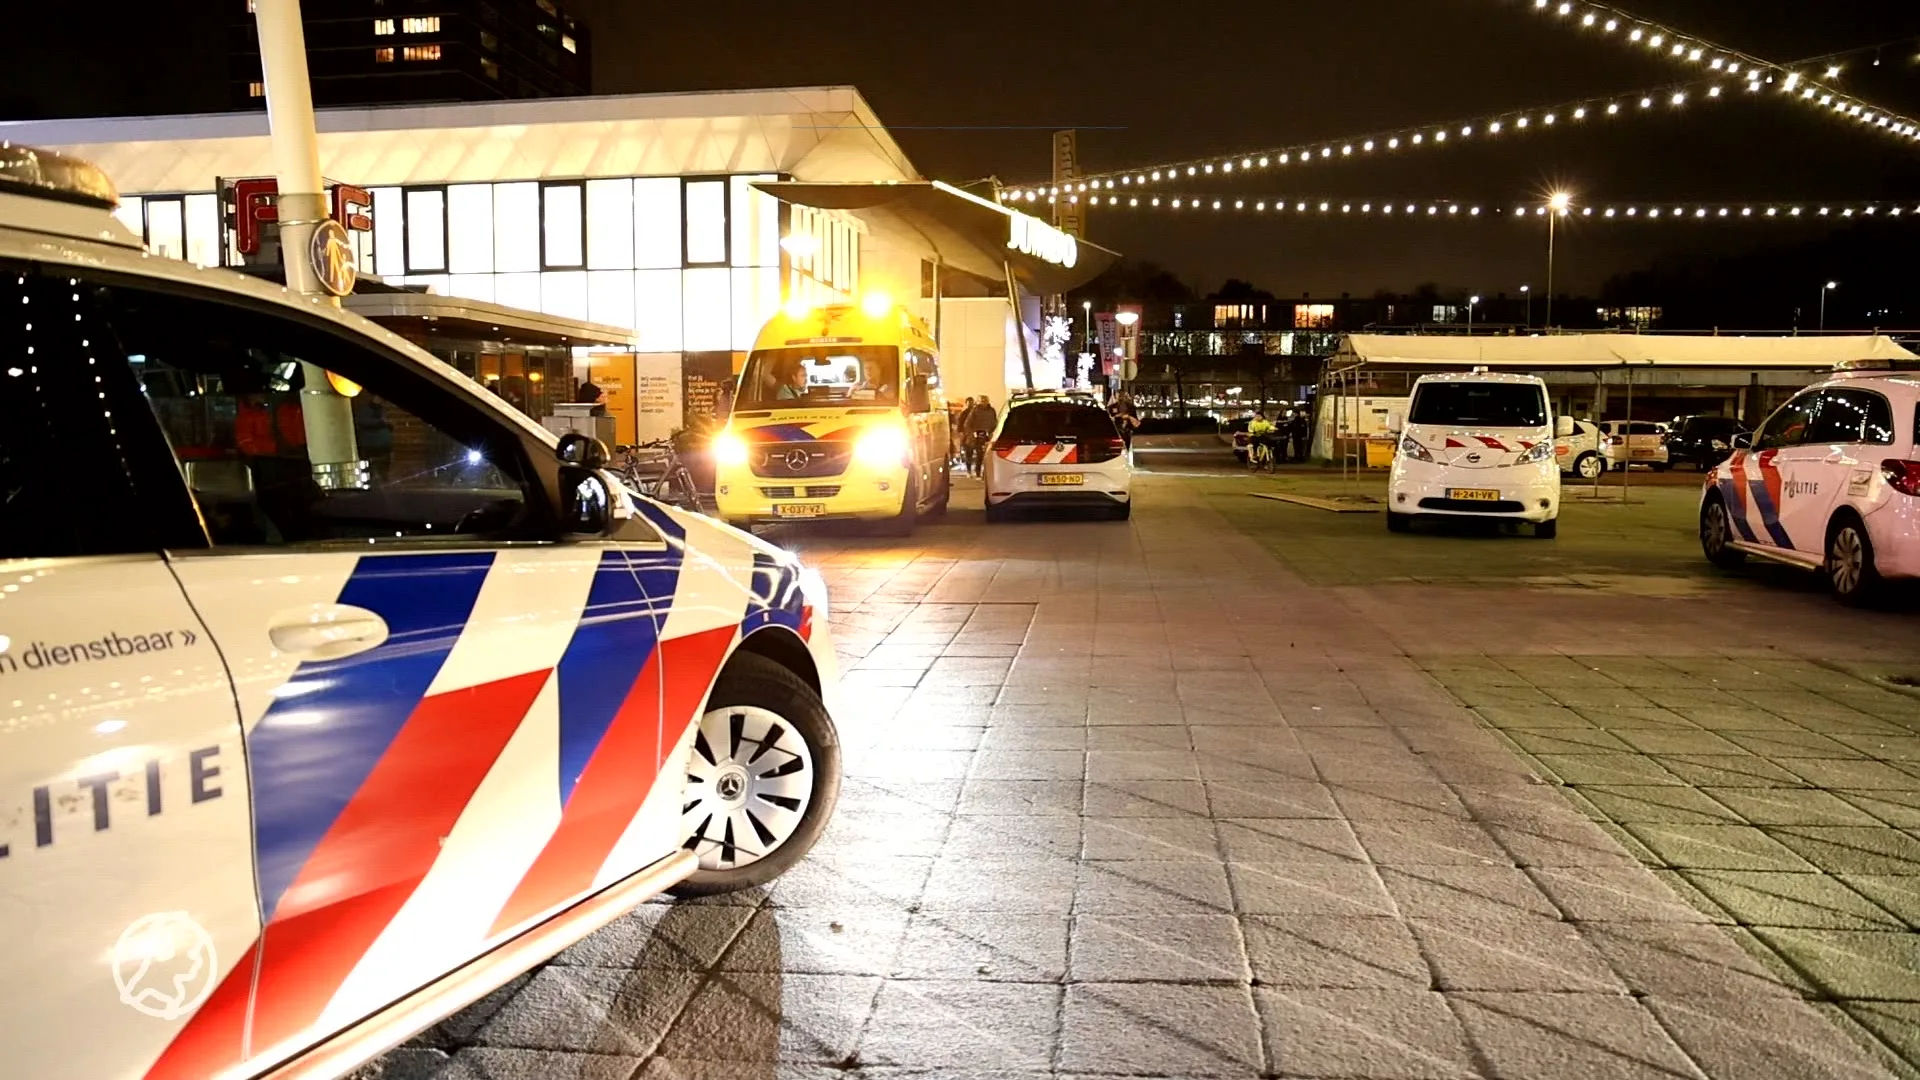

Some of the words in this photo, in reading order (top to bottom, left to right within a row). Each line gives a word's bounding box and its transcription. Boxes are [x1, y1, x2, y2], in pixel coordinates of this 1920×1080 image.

[1453, 491, 1494, 500] H-241-VK
[781, 505, 821, 514] X-037-VZ
[23, 631, 174, 670] dienstbaar
